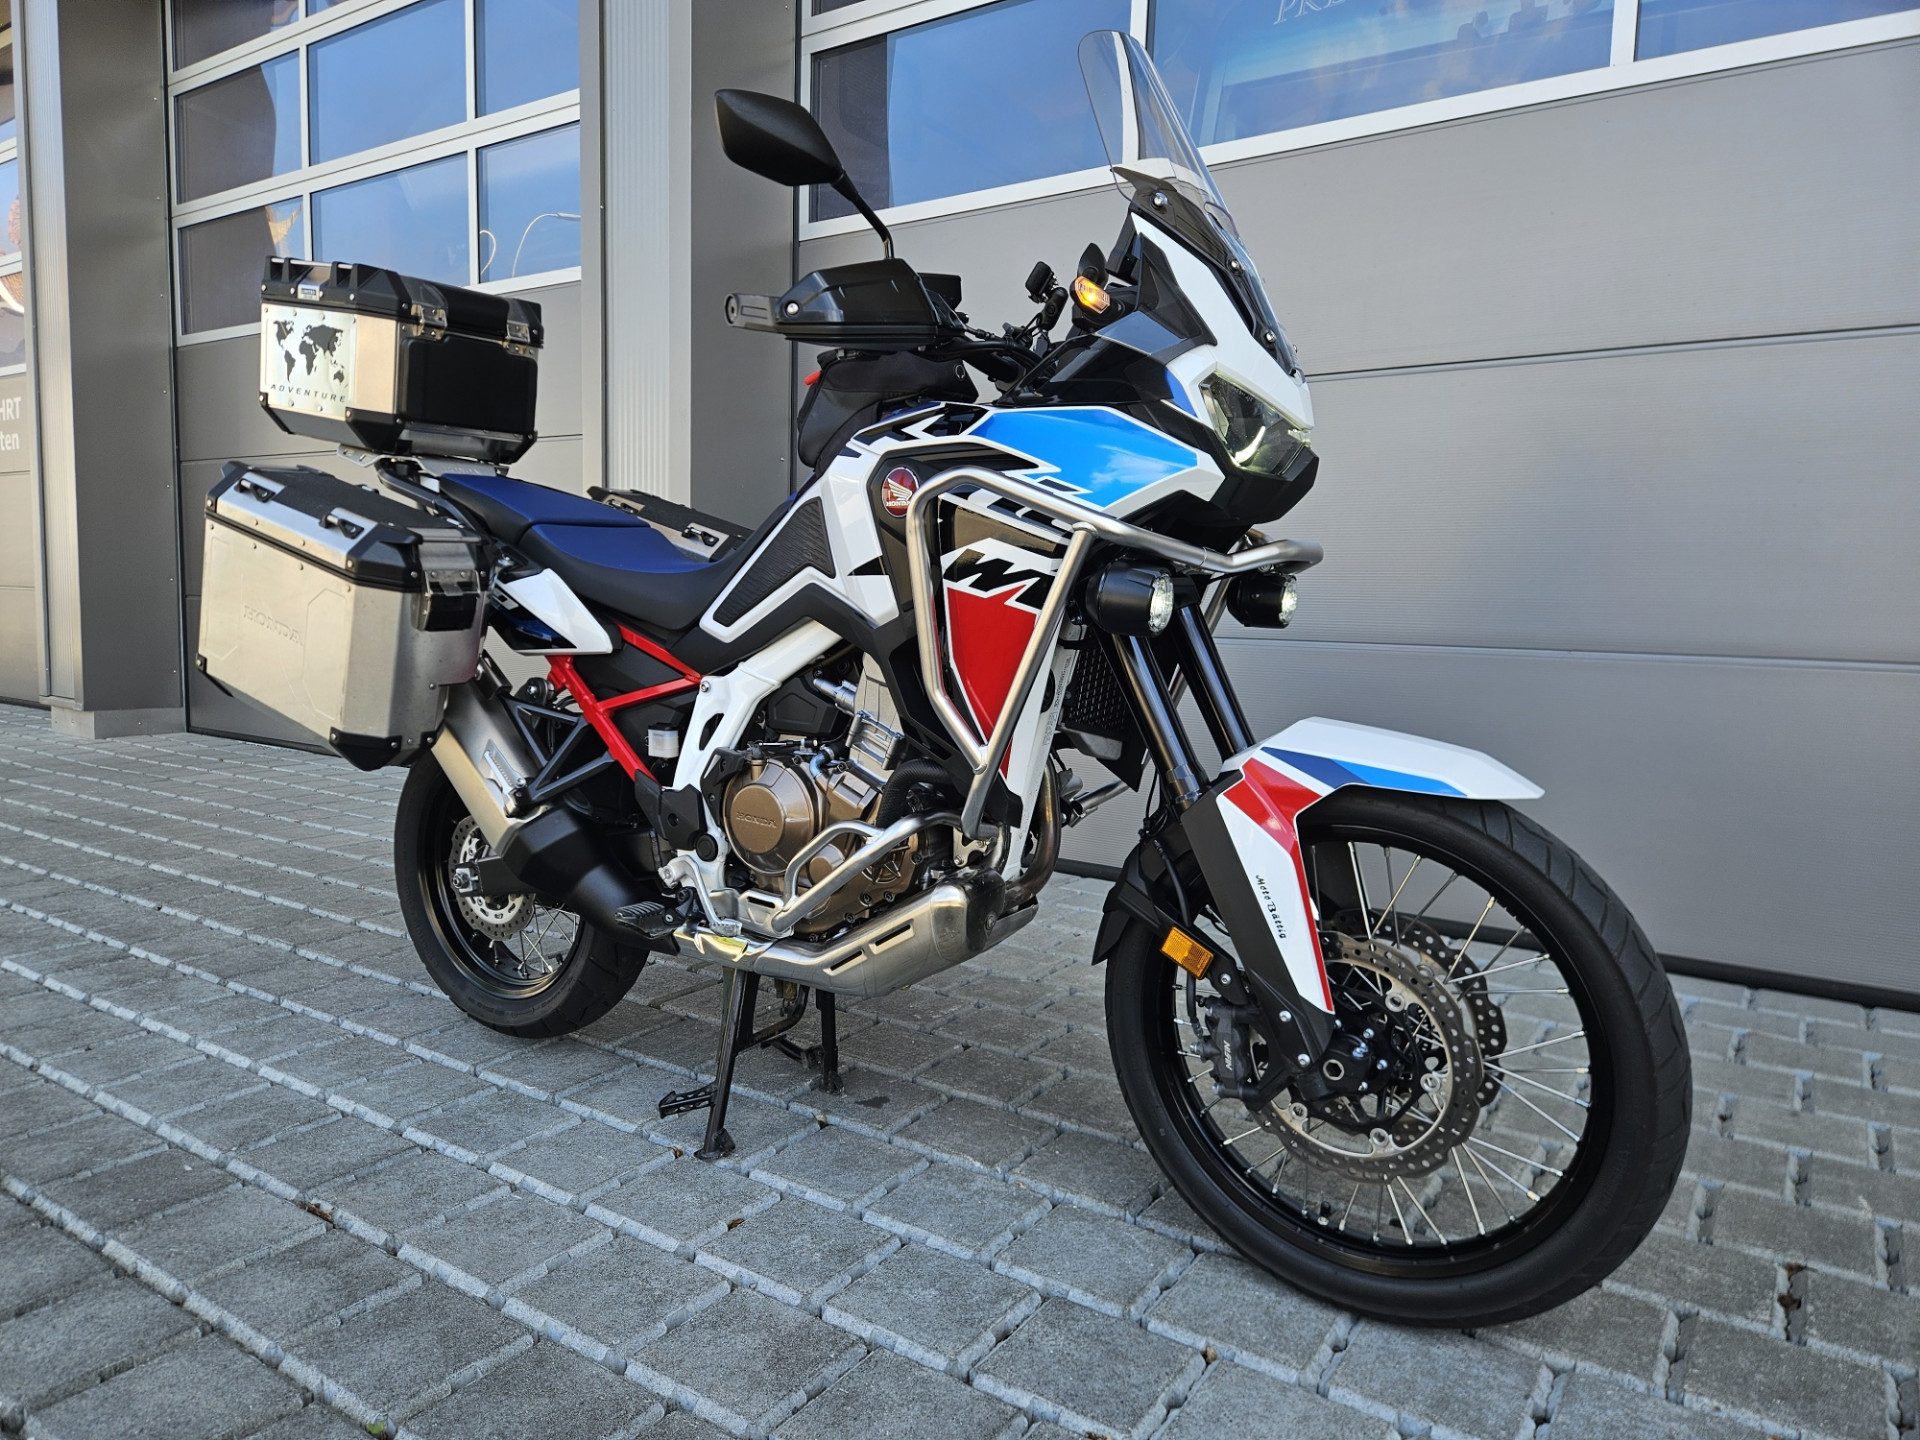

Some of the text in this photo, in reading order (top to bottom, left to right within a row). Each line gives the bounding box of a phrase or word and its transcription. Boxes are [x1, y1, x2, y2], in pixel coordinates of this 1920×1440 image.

[271, 383, 347, 403] ADVENTURE
[243, 604, 303, 646] HONDA
[736, 811, 777, 829] HONDA
[1255, 874, 1272, 901] Moto
